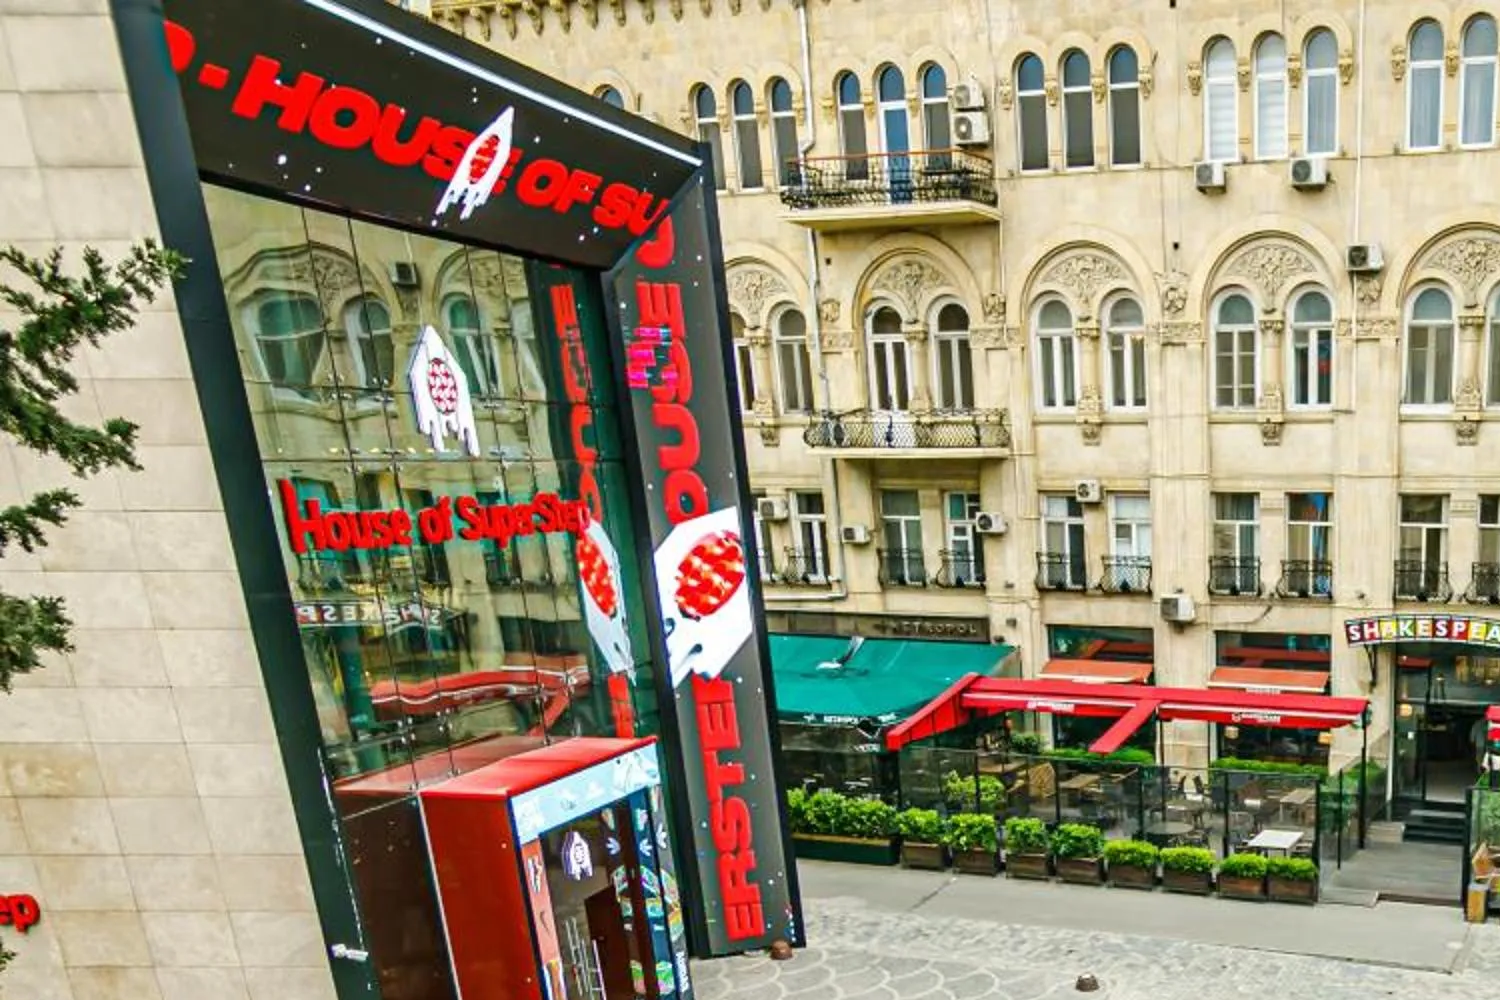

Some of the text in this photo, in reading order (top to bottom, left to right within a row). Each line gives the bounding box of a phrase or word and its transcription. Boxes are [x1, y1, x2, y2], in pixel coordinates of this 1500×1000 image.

[516, 158, 603, 213] OF
[279, 478, 591, 554] House of SuperStep
